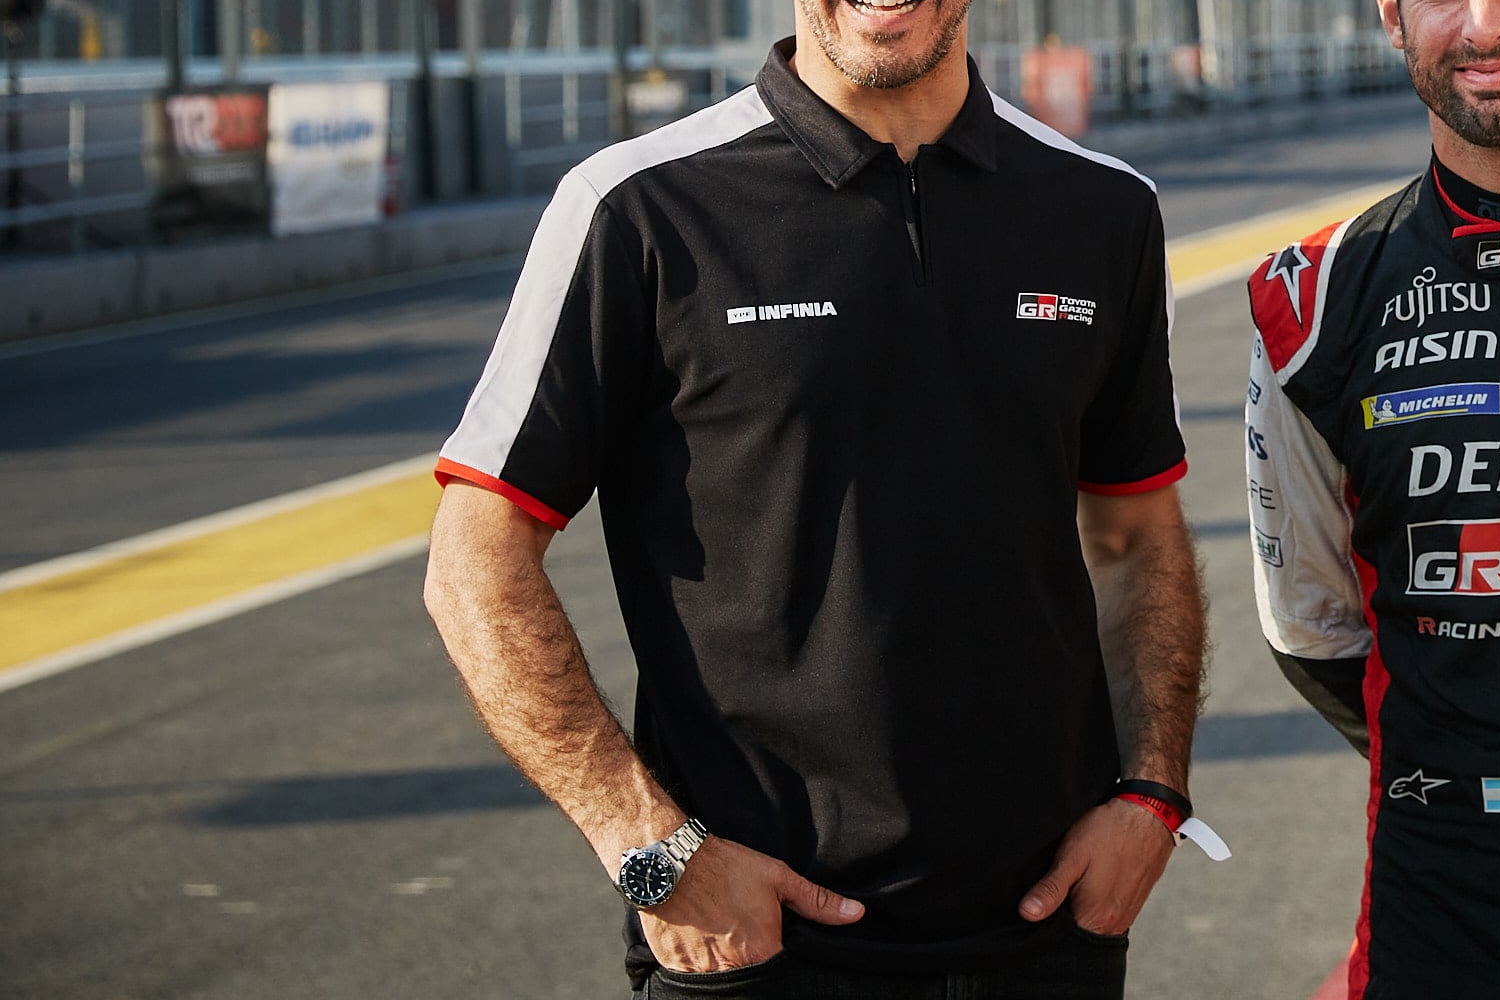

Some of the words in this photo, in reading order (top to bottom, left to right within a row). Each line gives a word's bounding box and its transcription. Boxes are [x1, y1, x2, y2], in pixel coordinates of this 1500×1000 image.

[1059, 296, 1097, 309] TOYOTA
[1380, 267, 1491, 328] FUJITSU
[758, 301, 838, 321] INFINIA
[1019, 303, 1056, 318] GR
[1058, 304, 1094, 316] GAZOO
[1058, 312, 1093, 325] Racing
[1374, 330, 1498, 374] AISIN
[1398, 393, 1488, 414] MICHELIN
